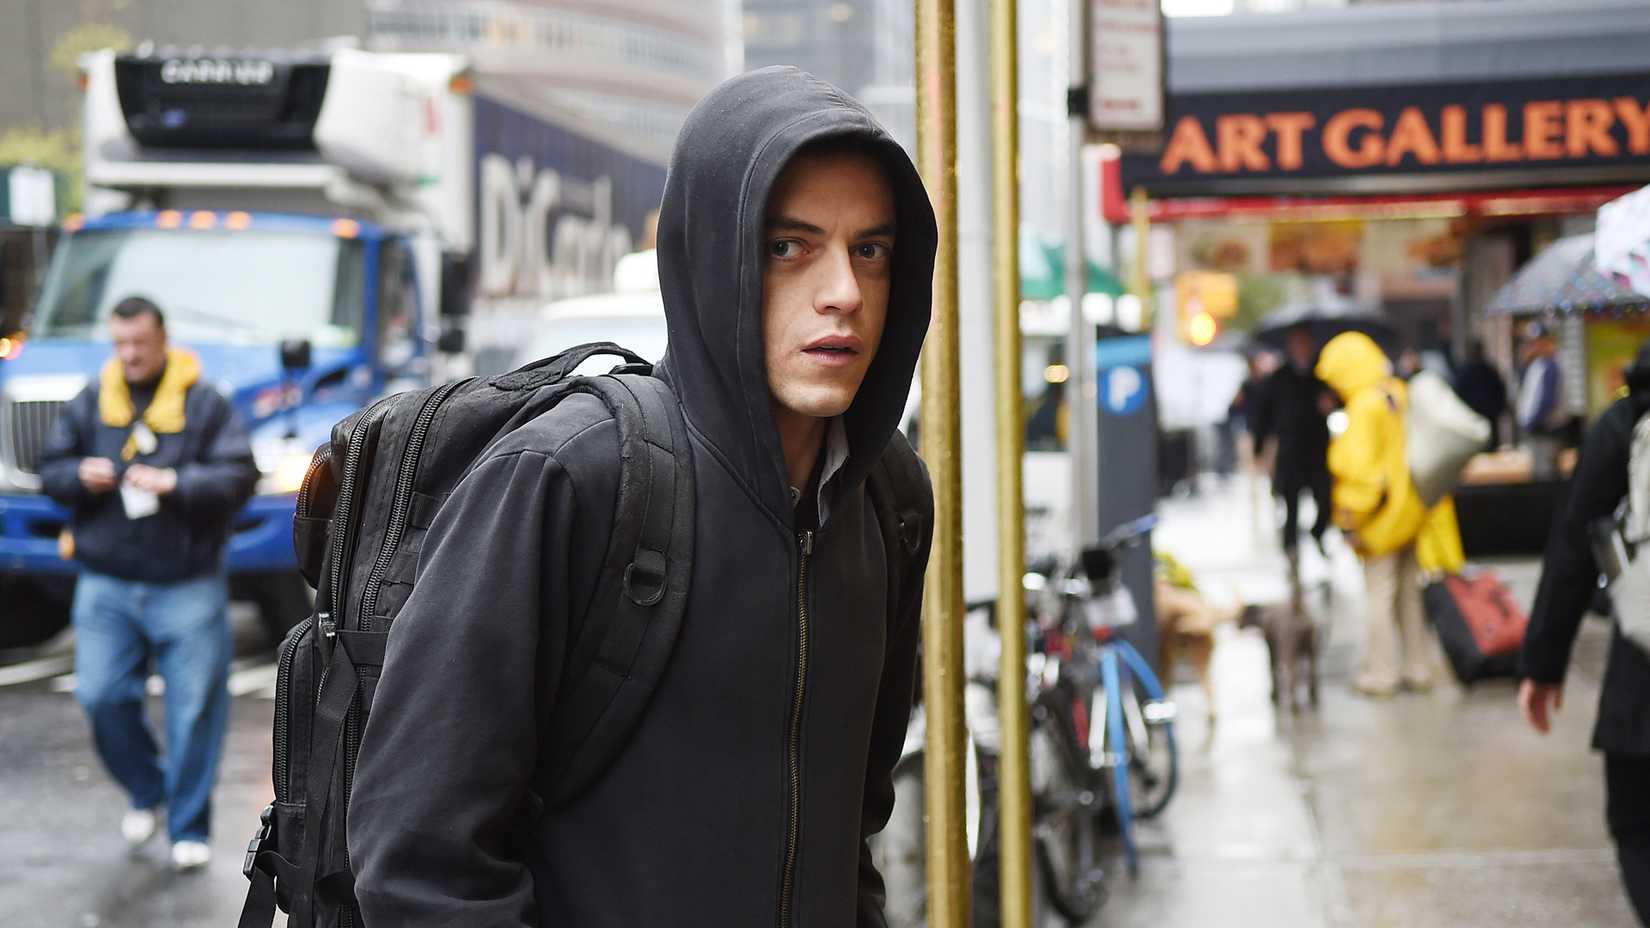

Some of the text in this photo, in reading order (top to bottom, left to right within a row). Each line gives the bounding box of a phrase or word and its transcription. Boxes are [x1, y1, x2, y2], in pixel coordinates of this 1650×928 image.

[1160, 97, 1650, 174] ART GALLERY
[1108, 367, 1141, 412] P
